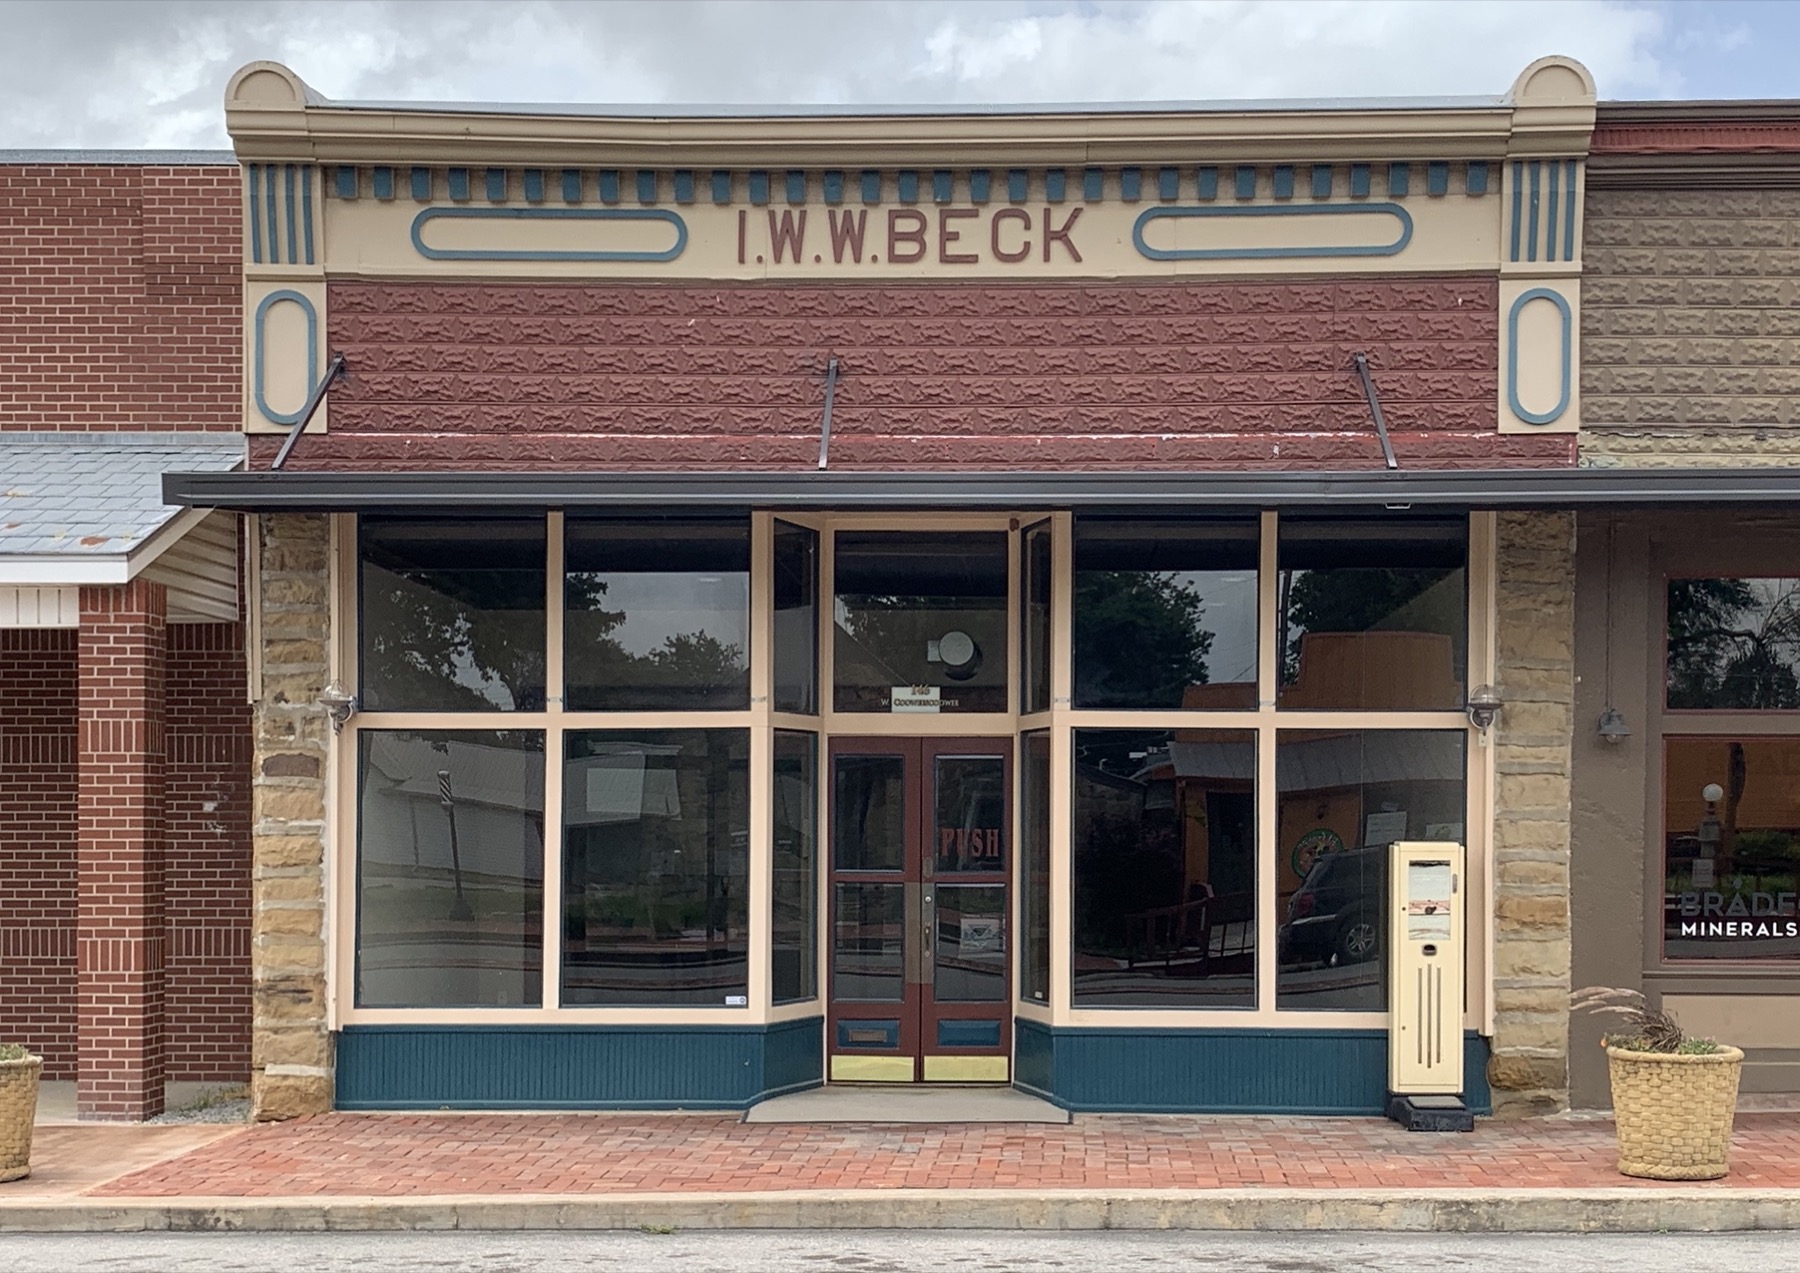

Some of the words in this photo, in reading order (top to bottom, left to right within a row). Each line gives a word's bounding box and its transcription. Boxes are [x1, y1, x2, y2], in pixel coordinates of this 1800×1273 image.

[940, 828, 1000, 858] PUSH
[1681, 891, 1800, 917] BRADF
[1681, 921, 1798, 937] MINERALS
